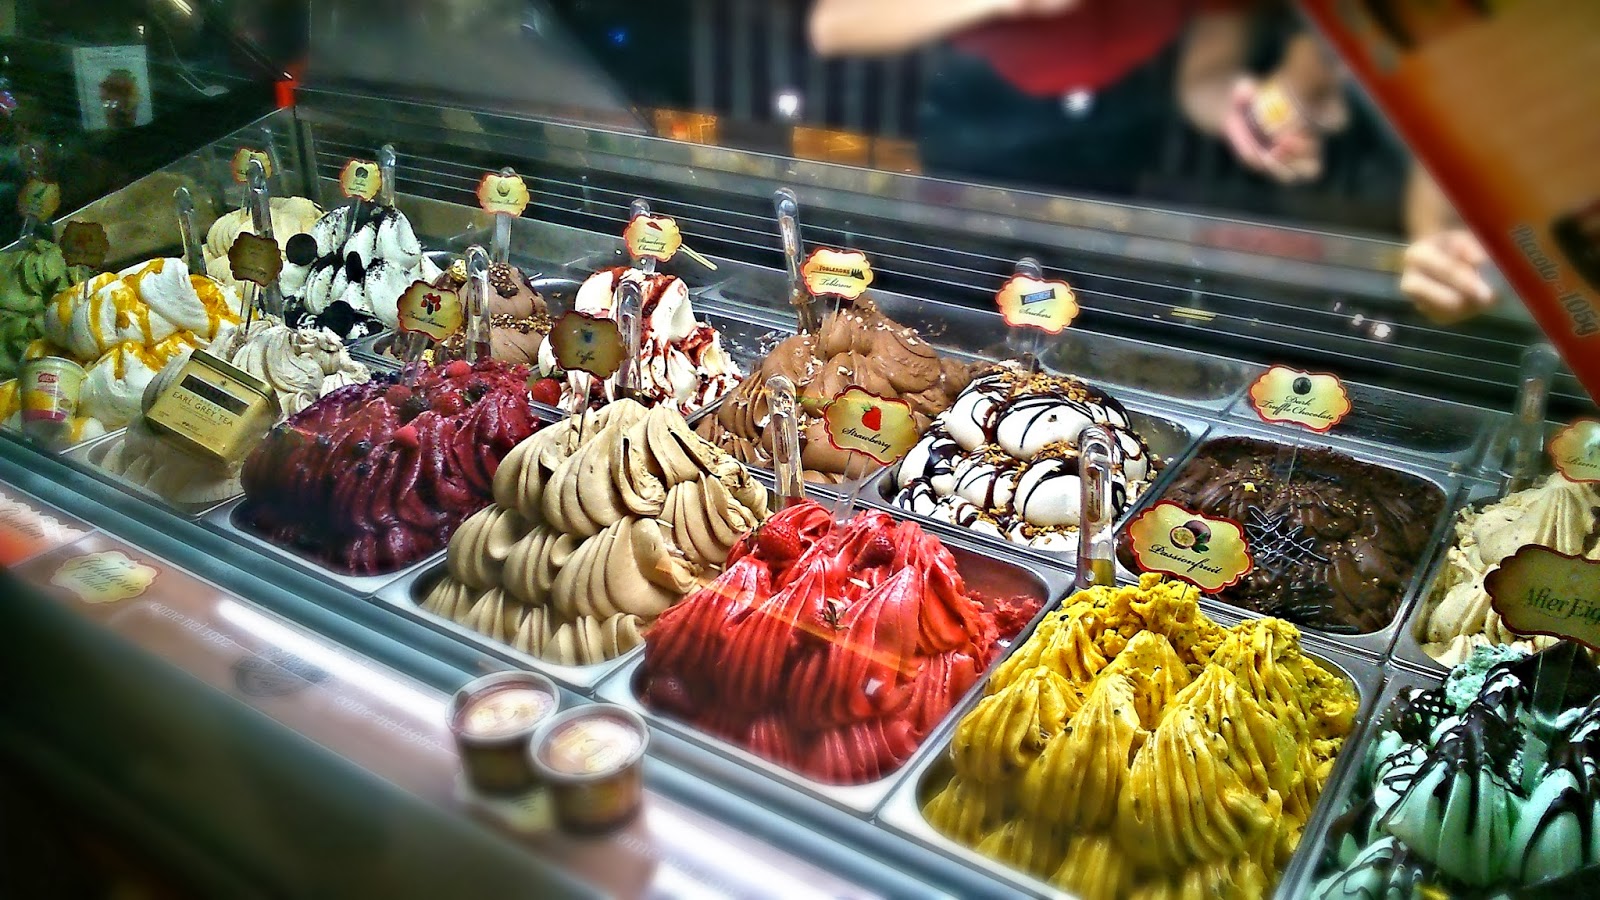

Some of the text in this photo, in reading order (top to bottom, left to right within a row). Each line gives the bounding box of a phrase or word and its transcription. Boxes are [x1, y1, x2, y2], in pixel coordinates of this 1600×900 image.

[1509, 223, 1560, 281] Piccolo
[818, 264, 850, 275] TOBLERONE
[818, 277, 852, 289] Toblerone
[173, 392, 192, 406] EARL
[194, 403, 217, 417] GREY
[219, 415, 234, 427] TEA
[1258, 400, 1334, 420] Truffle Chocolate
[1284, 395, 1316, 407] Dark
[841, 427, 892, 454] Strawberry
[1148, 543, 1223, 574] Passionfruit
[150, 602, 185, 621] come
